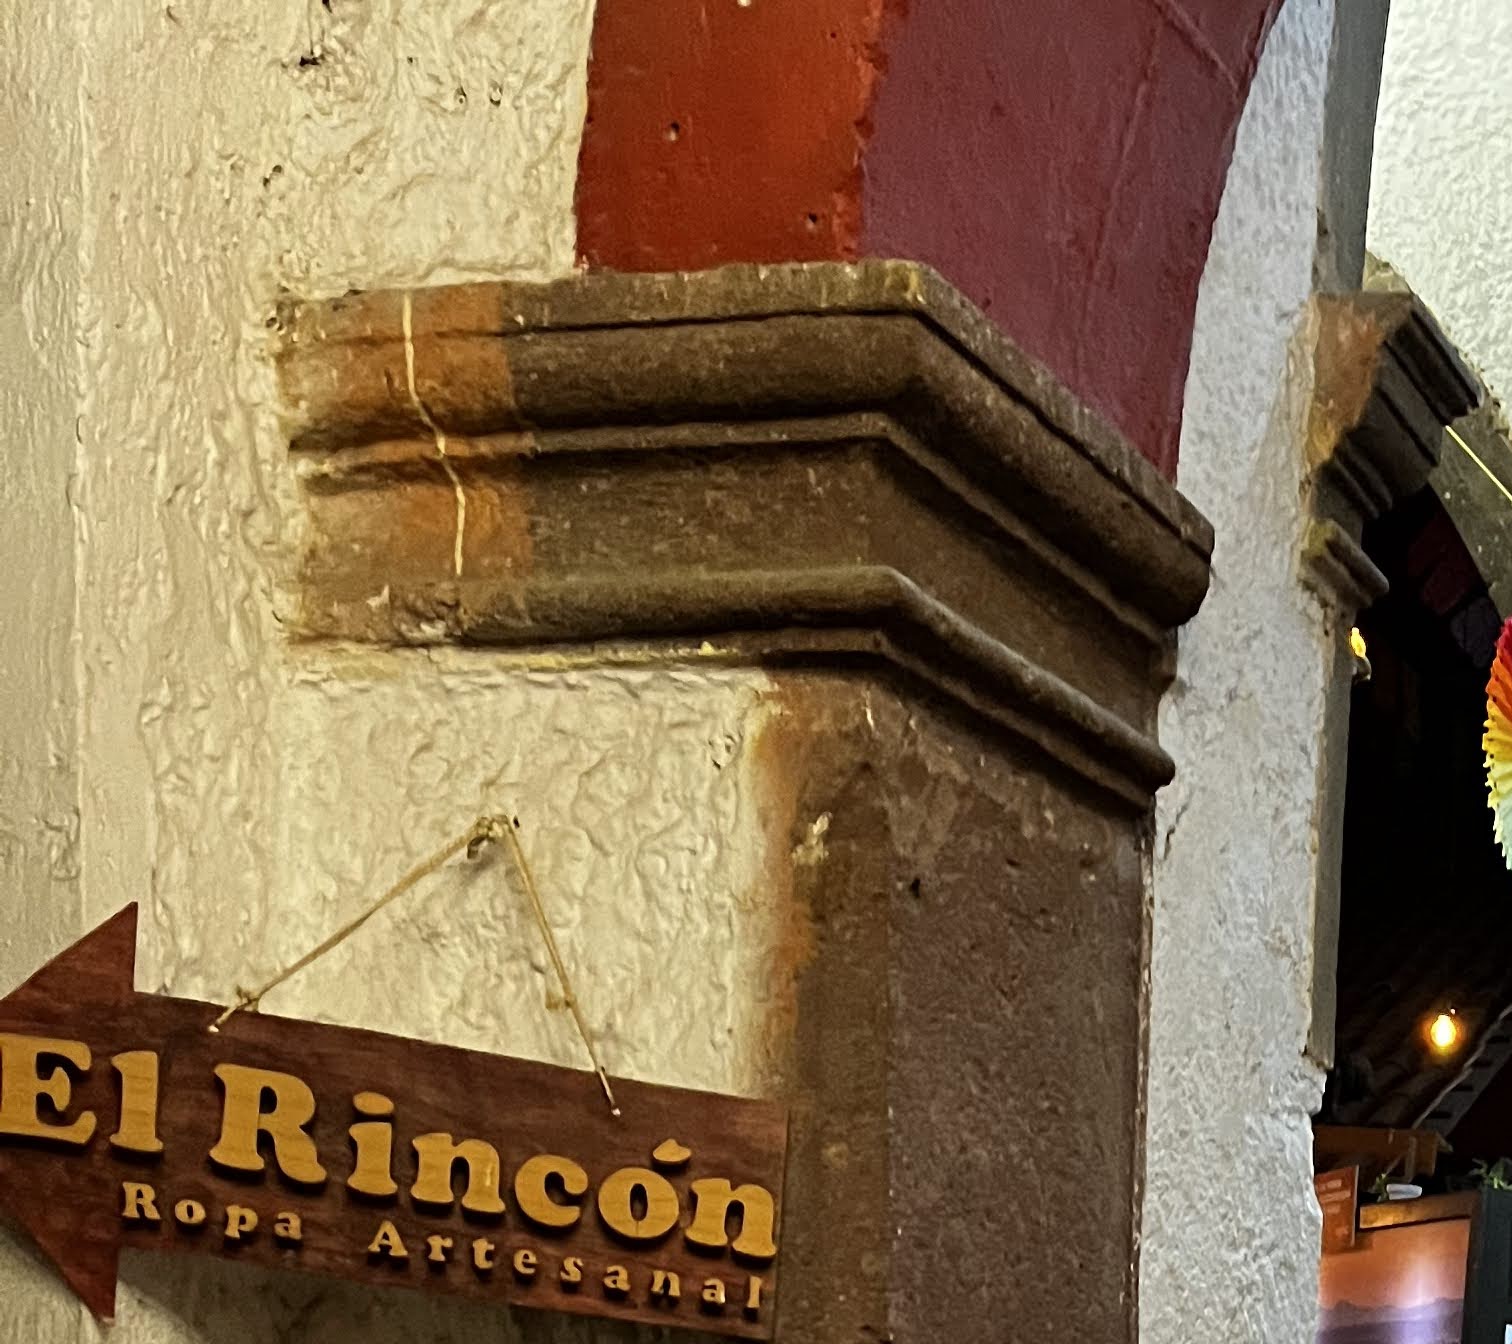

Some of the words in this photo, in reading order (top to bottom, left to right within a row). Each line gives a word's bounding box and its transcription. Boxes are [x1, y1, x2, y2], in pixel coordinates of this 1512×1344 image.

[0, 1033, 163, 1153] El
[209, 1062, 778, 1259] Rincón
[122, 1181, 304, 1242] Ropa
[368, 1221, 762, 1310] Artesanal
